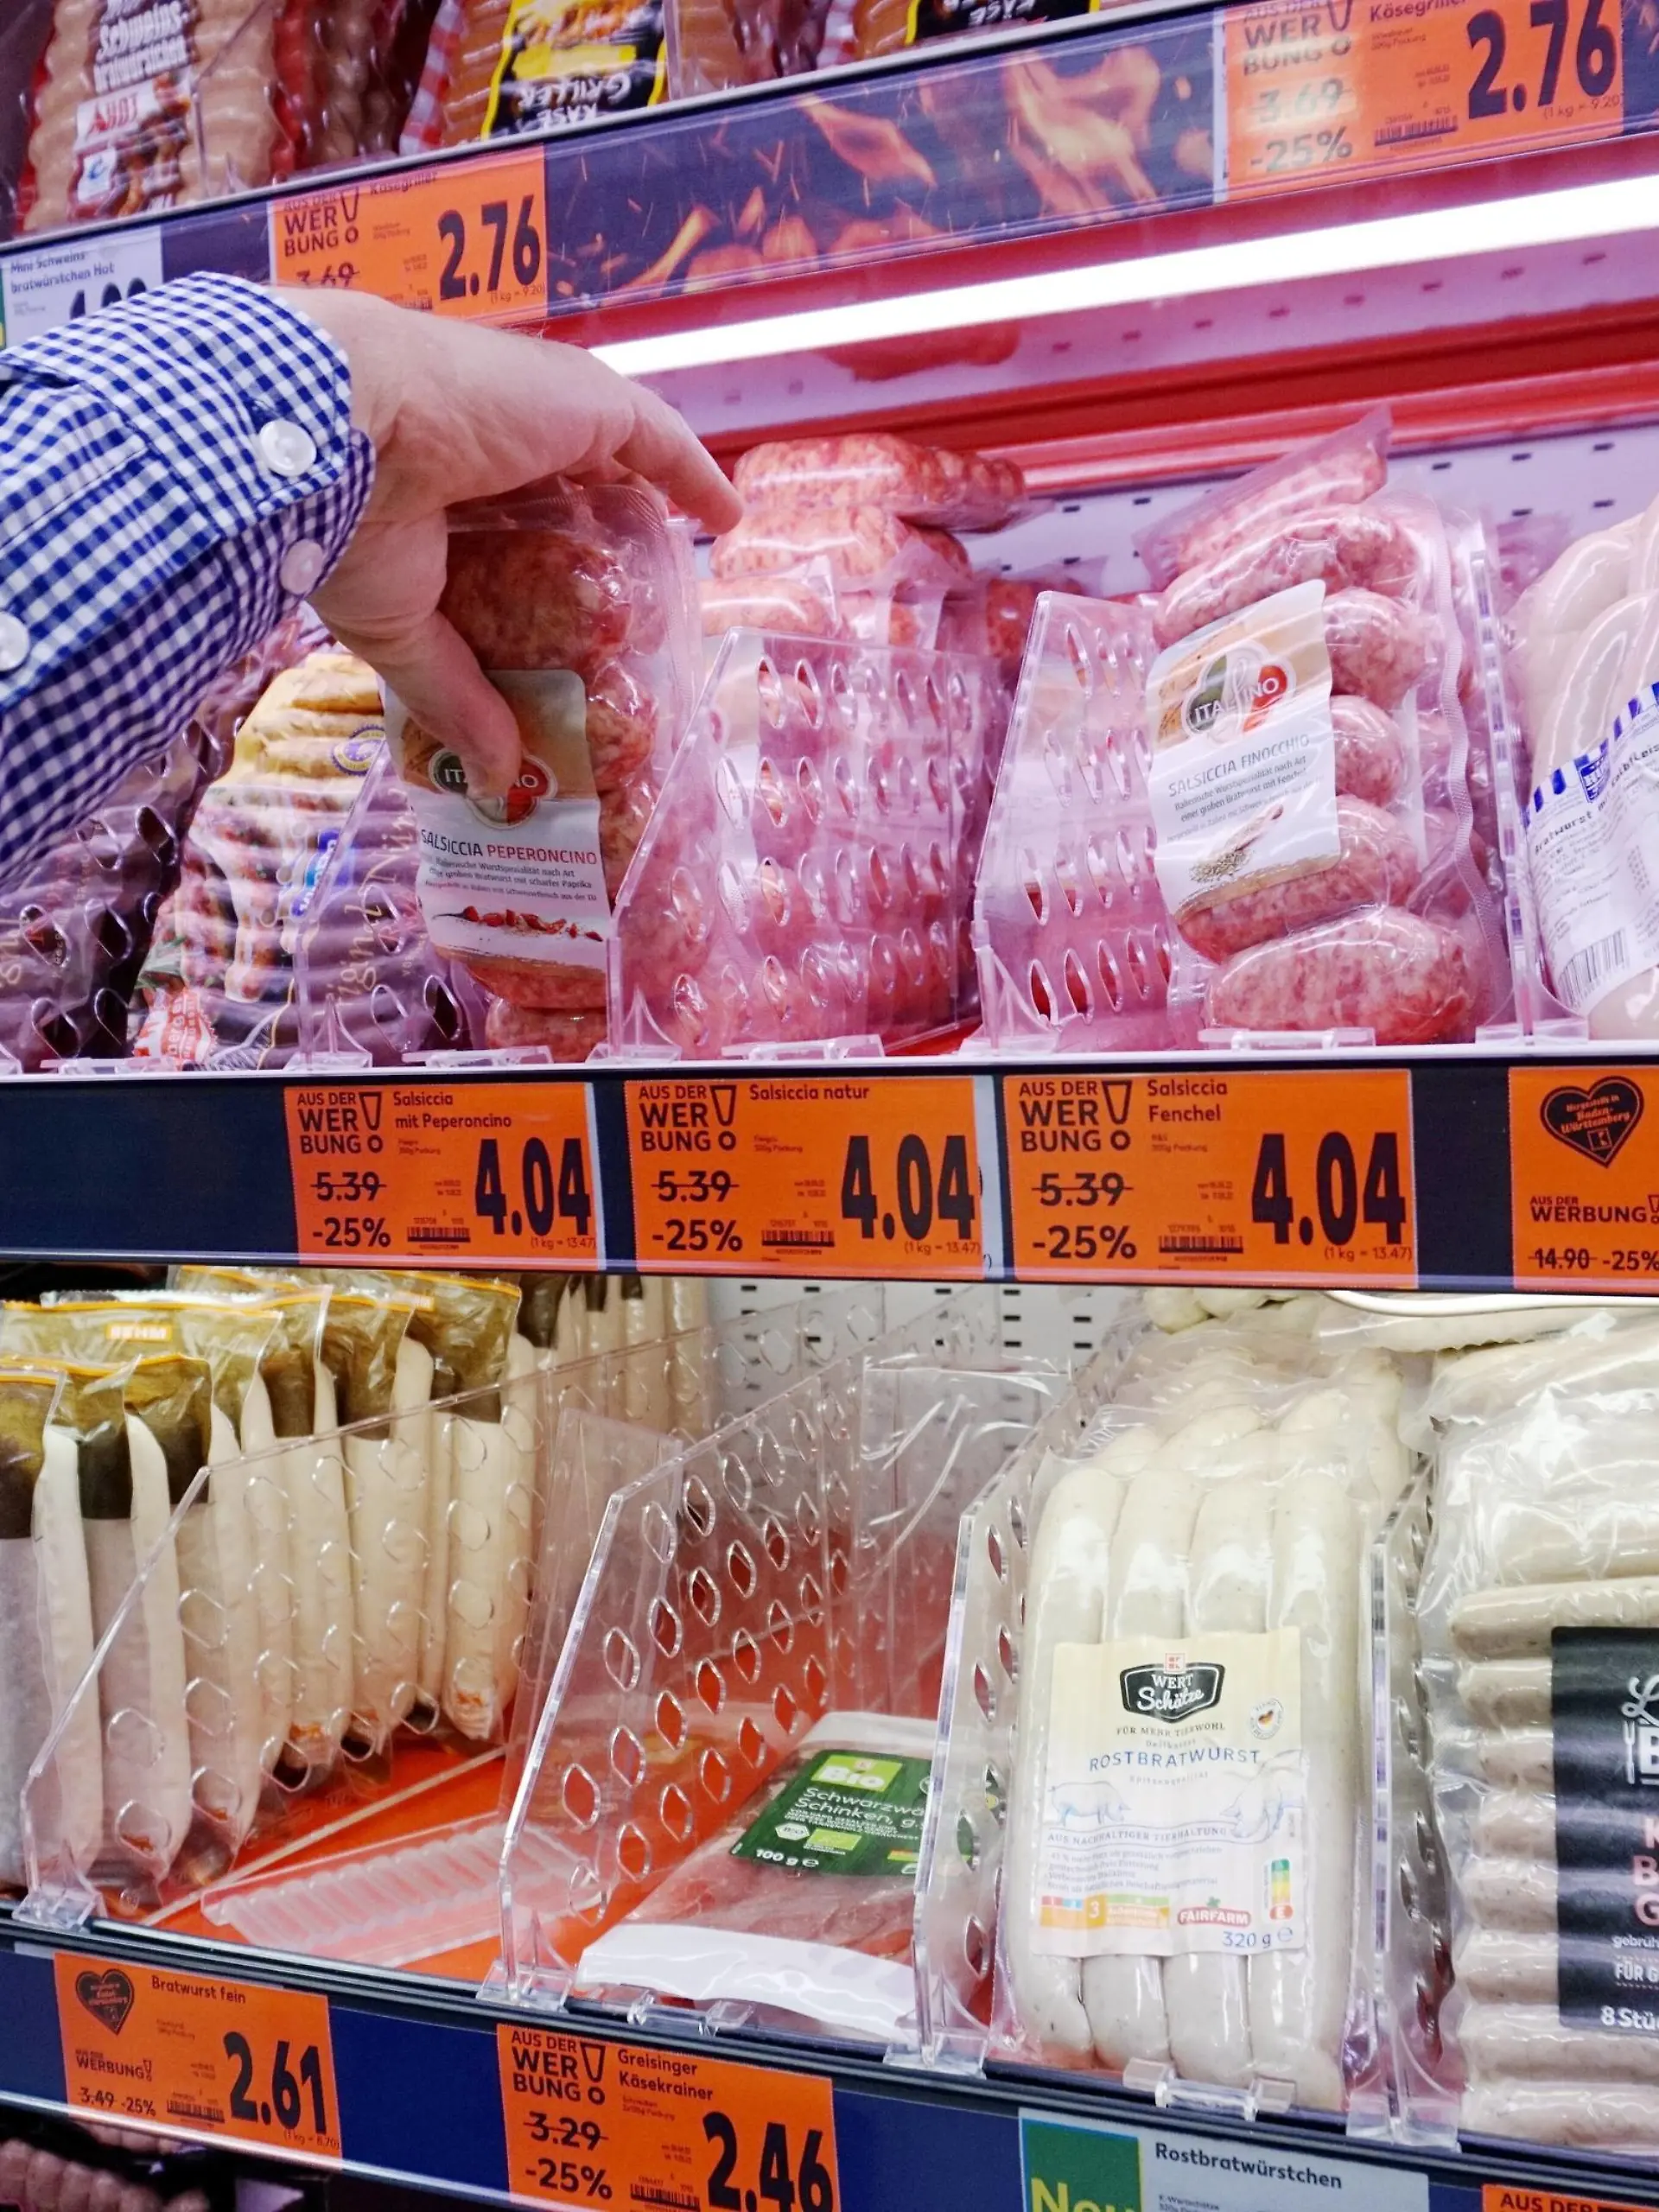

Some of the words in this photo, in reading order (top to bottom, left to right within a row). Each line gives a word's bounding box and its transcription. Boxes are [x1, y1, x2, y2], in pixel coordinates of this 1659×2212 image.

[1244, 15, 1321, 49] WER
[1467, 0, 1618, 120] 2.76
[1250, 126, 1352, 174] -25%
[284, 205, 338, 237] WER
[284, 232, 339, 257] BUNG
[438, 194, 541, 301] 2.76
[1168, 760, 1237, 798] SALSICCIA
[1241, 734, 1310, 768] FINOCCHIO
[421, 829, 484, 856] SALSICCIA
[486, 844, 598, 865] PEPERONCINO
[297, 1092, 325, 1105] AUS
[328, 1092, 357, 1105] DER
[393, 1091, 454, 1107] Salsiccia
[639, 1085, 671, 1100] AUS
[676, 1085, 707, 1099] DER
[749, 1084, 819, 1101] Salsiccia
[823, 1085, 870, 1100] natur
[1019, 1081, 1056, 1096] AUS
[1062, 1081, 1097, 1096] DER
[1147, 1078, 1228, 1096] Salsiccia
[298, 1109, 358, 1132] WER
[395, 1115, 419, 1128] mit
[423, 1113, 512, 1132] Peperoncino
[639, 1103, 709, 1128] WER
[1020, 1100, 1099, 1127] WER
[1148, 1105, 1222, 1122] Fenchel
[301, 1135, 361, 1154] BUNG
[641, 1130, 711, 1152] BUNG
[1020, 1130, 1102, 1153] BUNG
[314, 1172, 384, 1202] 5.39
[475, 1136, 591, 1237] 4.04
[654, 1170, 737, 1202] 5.39
[842, 1134, 976, 1240] 4.04
[1036, 1172, 1128, 1207] 5.39
[1252, 1131, 1406, 1246] 4.04
[1530, 1196, 1552, 1205] AUS
[1556, 1196, 1579, 1205] DER
[313, 1217, 391, 1248] -25%
[652, 1218, 743, 1252] -25%
[1033, 1224, 1137, 1260] -25%
[916, 1240, 932, 1255] kg
[1336, 1246, 1355, 1262] kg
[1603, 1250, 1659, 1271] -25%
[1152, 1673, 1193, 1689] WERT
[1137, 1686, 1205, 1711] Schätze
[1116, 1726, 1137, 1736] FÜR
[1141, 1727, 1172, 1737] MEHR
[1175, 1722, 1226, 1737] TIERWOHL
[1089, 1745, 1261, 1772] ROSTBRATWURST
[1047, 1834, 1070, 1844] AUS
[1073, 1831, 1150, 1846] NACHHALTIGER
[1154, 1827, 1227, 1842] TIERHALTUNG
[755, 1848, 785, 1862] 100
[1089, 1901, 1100, 1918] 3
[1179, 1910, 1249, 1925] FAIRFARM
[1222, 1931, 1256, 1948] 320
[1262, 1934, 1272, 1948] g
[1615, 1961, 1642, 1982] FÜR
[151, 1974, 218, 1999] Bratwurst
[220, 1986, 246, 2004] fein
[1600, 2005, 1615, 2026] 8
[1618, 2006, 1659, 2031] Stü
[512, 2030, 542, 2048] AUS
[546, 2035, 577, 2054] DER
[512, 2045, 578, 2081] WER
[618, 2048, 698, 2076] Greisinger
[223, 2031, 327, 2135] 2.61
[512, 2071, 582, 2103] BUNG
[619, 2070, 714, 2101] Käsekrainer
[79, 2087, 116, 2107] 3.49
[122, 2095, 156, 2117] -25%
[526, 2110, 605, 2152] 3.29
[702, 2111, 834, 2212] 2.46
[1155, 2142, 1343, 2190] Rostbratwürstchen
[524, 2158, 613, 2200] -25%
[1500, 2193, 1543, 2212] AUS
